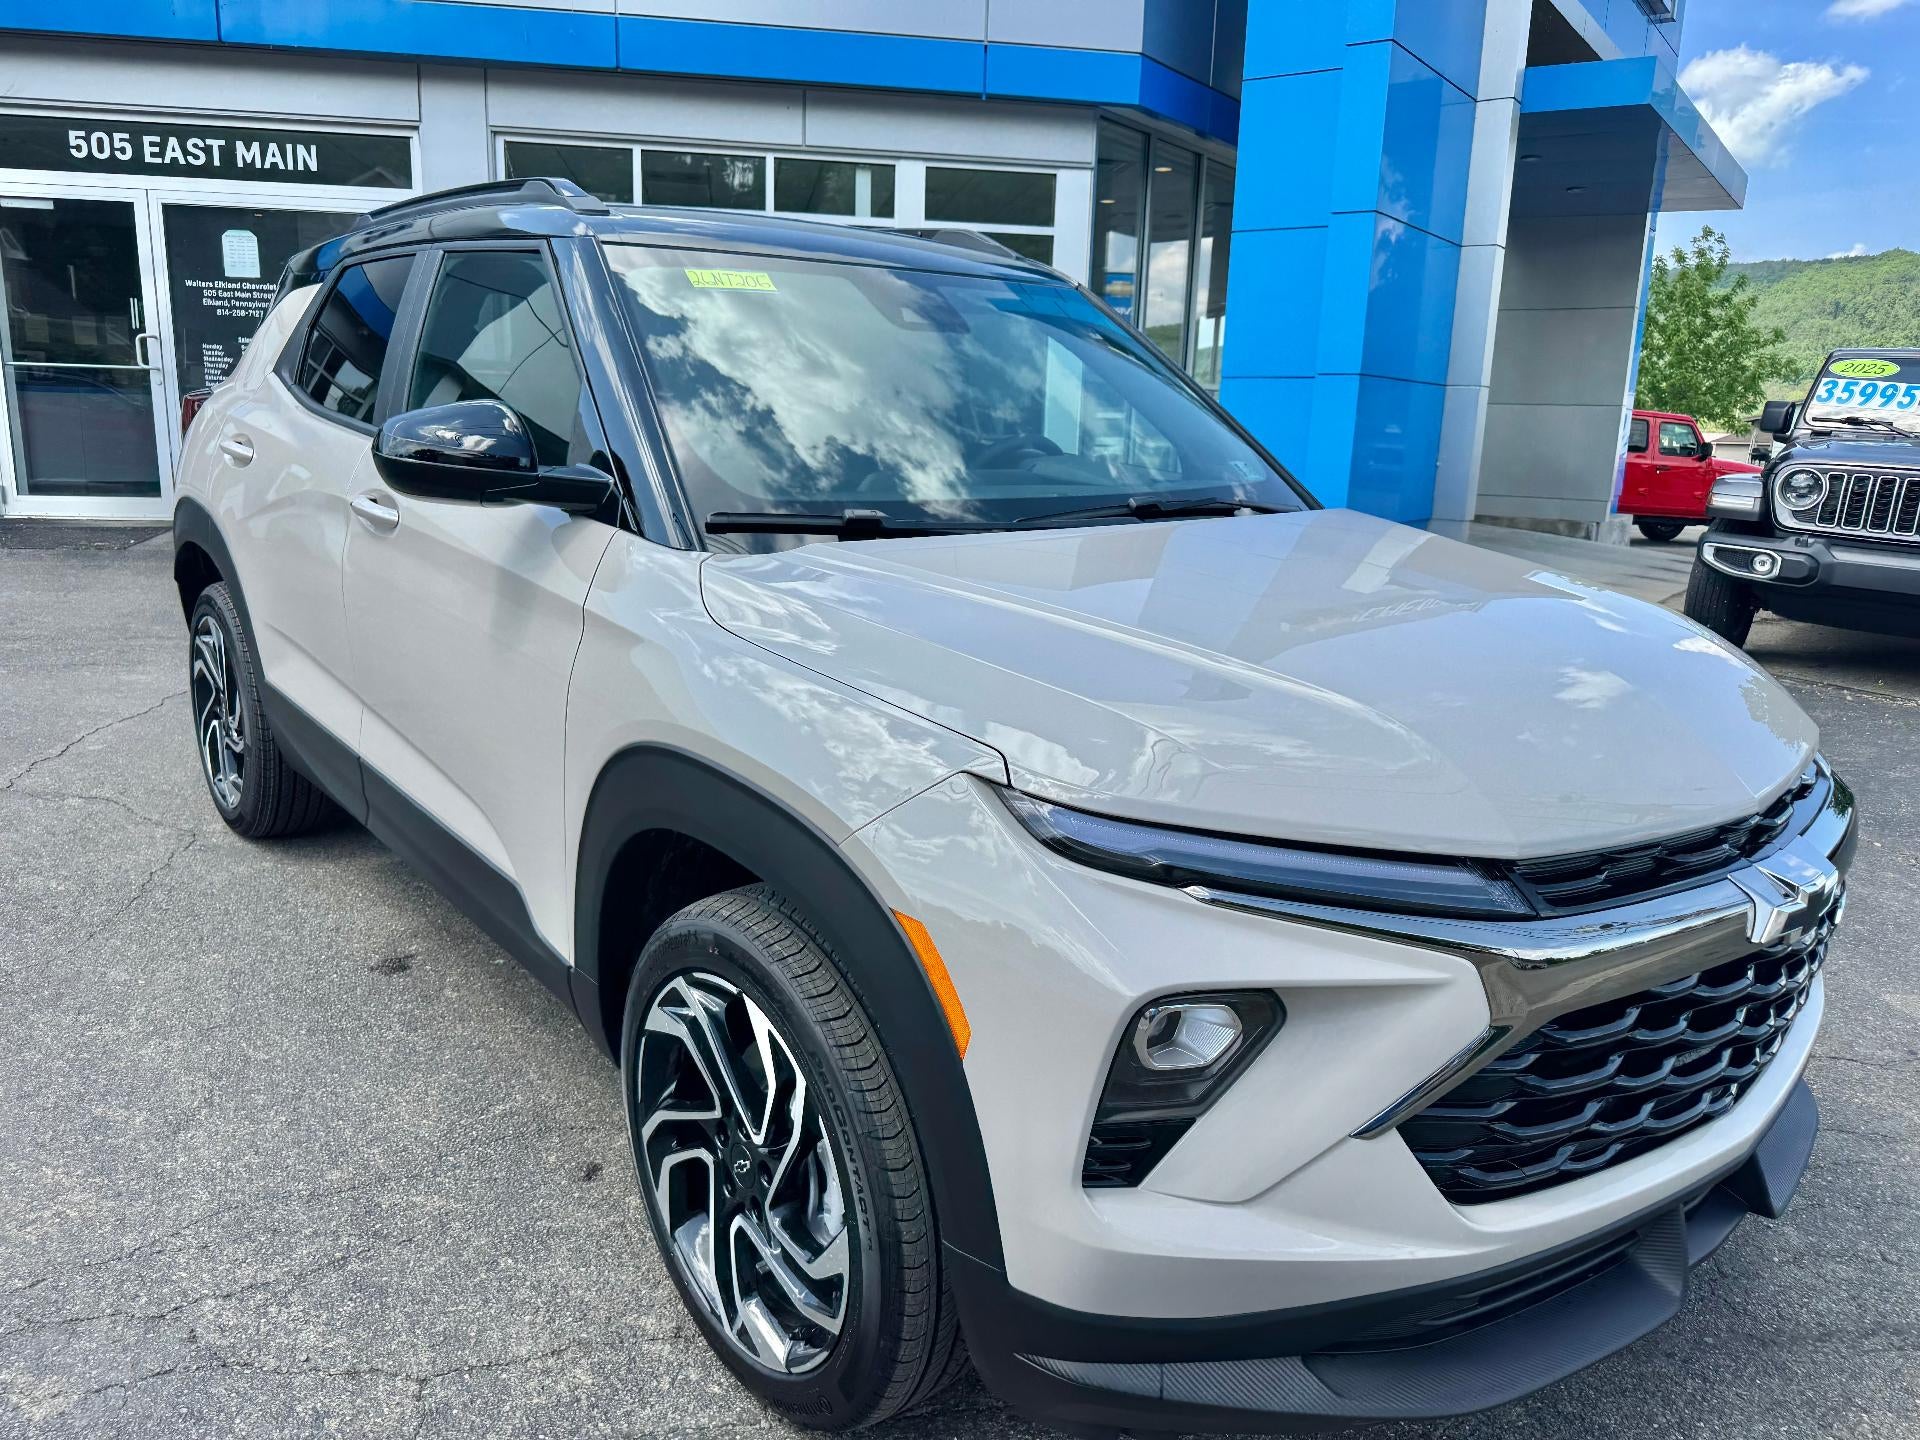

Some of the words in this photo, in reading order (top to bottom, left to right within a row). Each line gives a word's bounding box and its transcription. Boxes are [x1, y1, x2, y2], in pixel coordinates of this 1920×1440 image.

[68, 130, 133, 160] 505
[142, 135, 226, 167] EAST
[235, 140, 319, 172] MAIN
[185, 279, 214, 288] Walters
[214, 281, 241, 289] Elkland
[242, 282, 277, 291] Chevrolet
[203, 289, 217, 297] 505
[218, 290, 234, 298] East
[235, 290, 252, 299] Main
[202, 343, 223, 351] Monday
[203, 349, 225, 357] Tuesday
[1840, 362, 1889, 375] 2025
[1815, 379, 1920, 409] 35995
